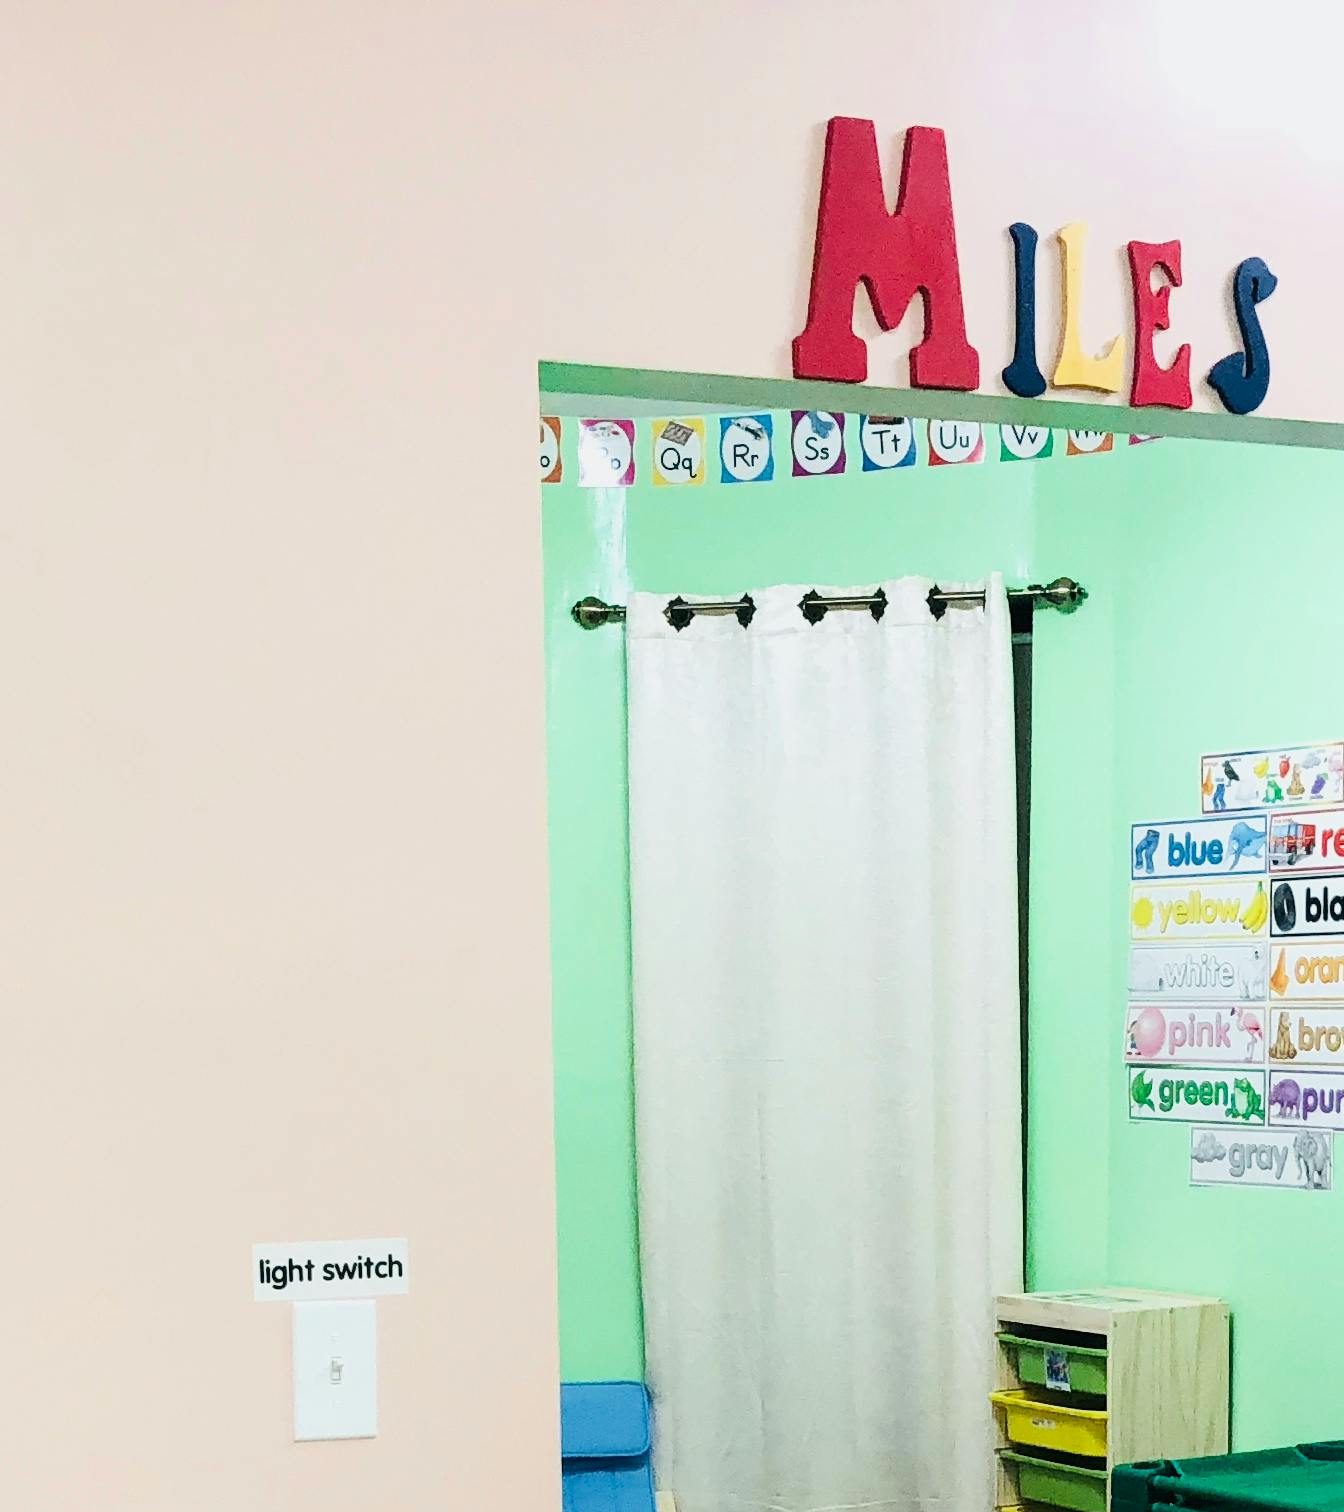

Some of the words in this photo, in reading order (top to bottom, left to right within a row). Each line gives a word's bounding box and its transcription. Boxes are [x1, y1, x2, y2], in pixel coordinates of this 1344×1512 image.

[805, 437, 830, 461] Ss
[871, 430, 901, 454] Tt
[939, 425, 970, 450] Uu
[1011, 425, 1039, 445] Vv
[660, 447, 697, 478] Qq
[733, 443, 759, 468] Rr
[1167, 832, 1224, 869] blue
[1158, 890, 1242, 933] yellow
[1164, 953, 1236, 989] white
[1169, 1013, 1232, 1056] pink
[1158, 1079, 1229, 1113] green
[1229, 1139, 1288, 1181] gray
[259, 1258, 315, 1290] light
[322, 1254, 403, 1281] switch
